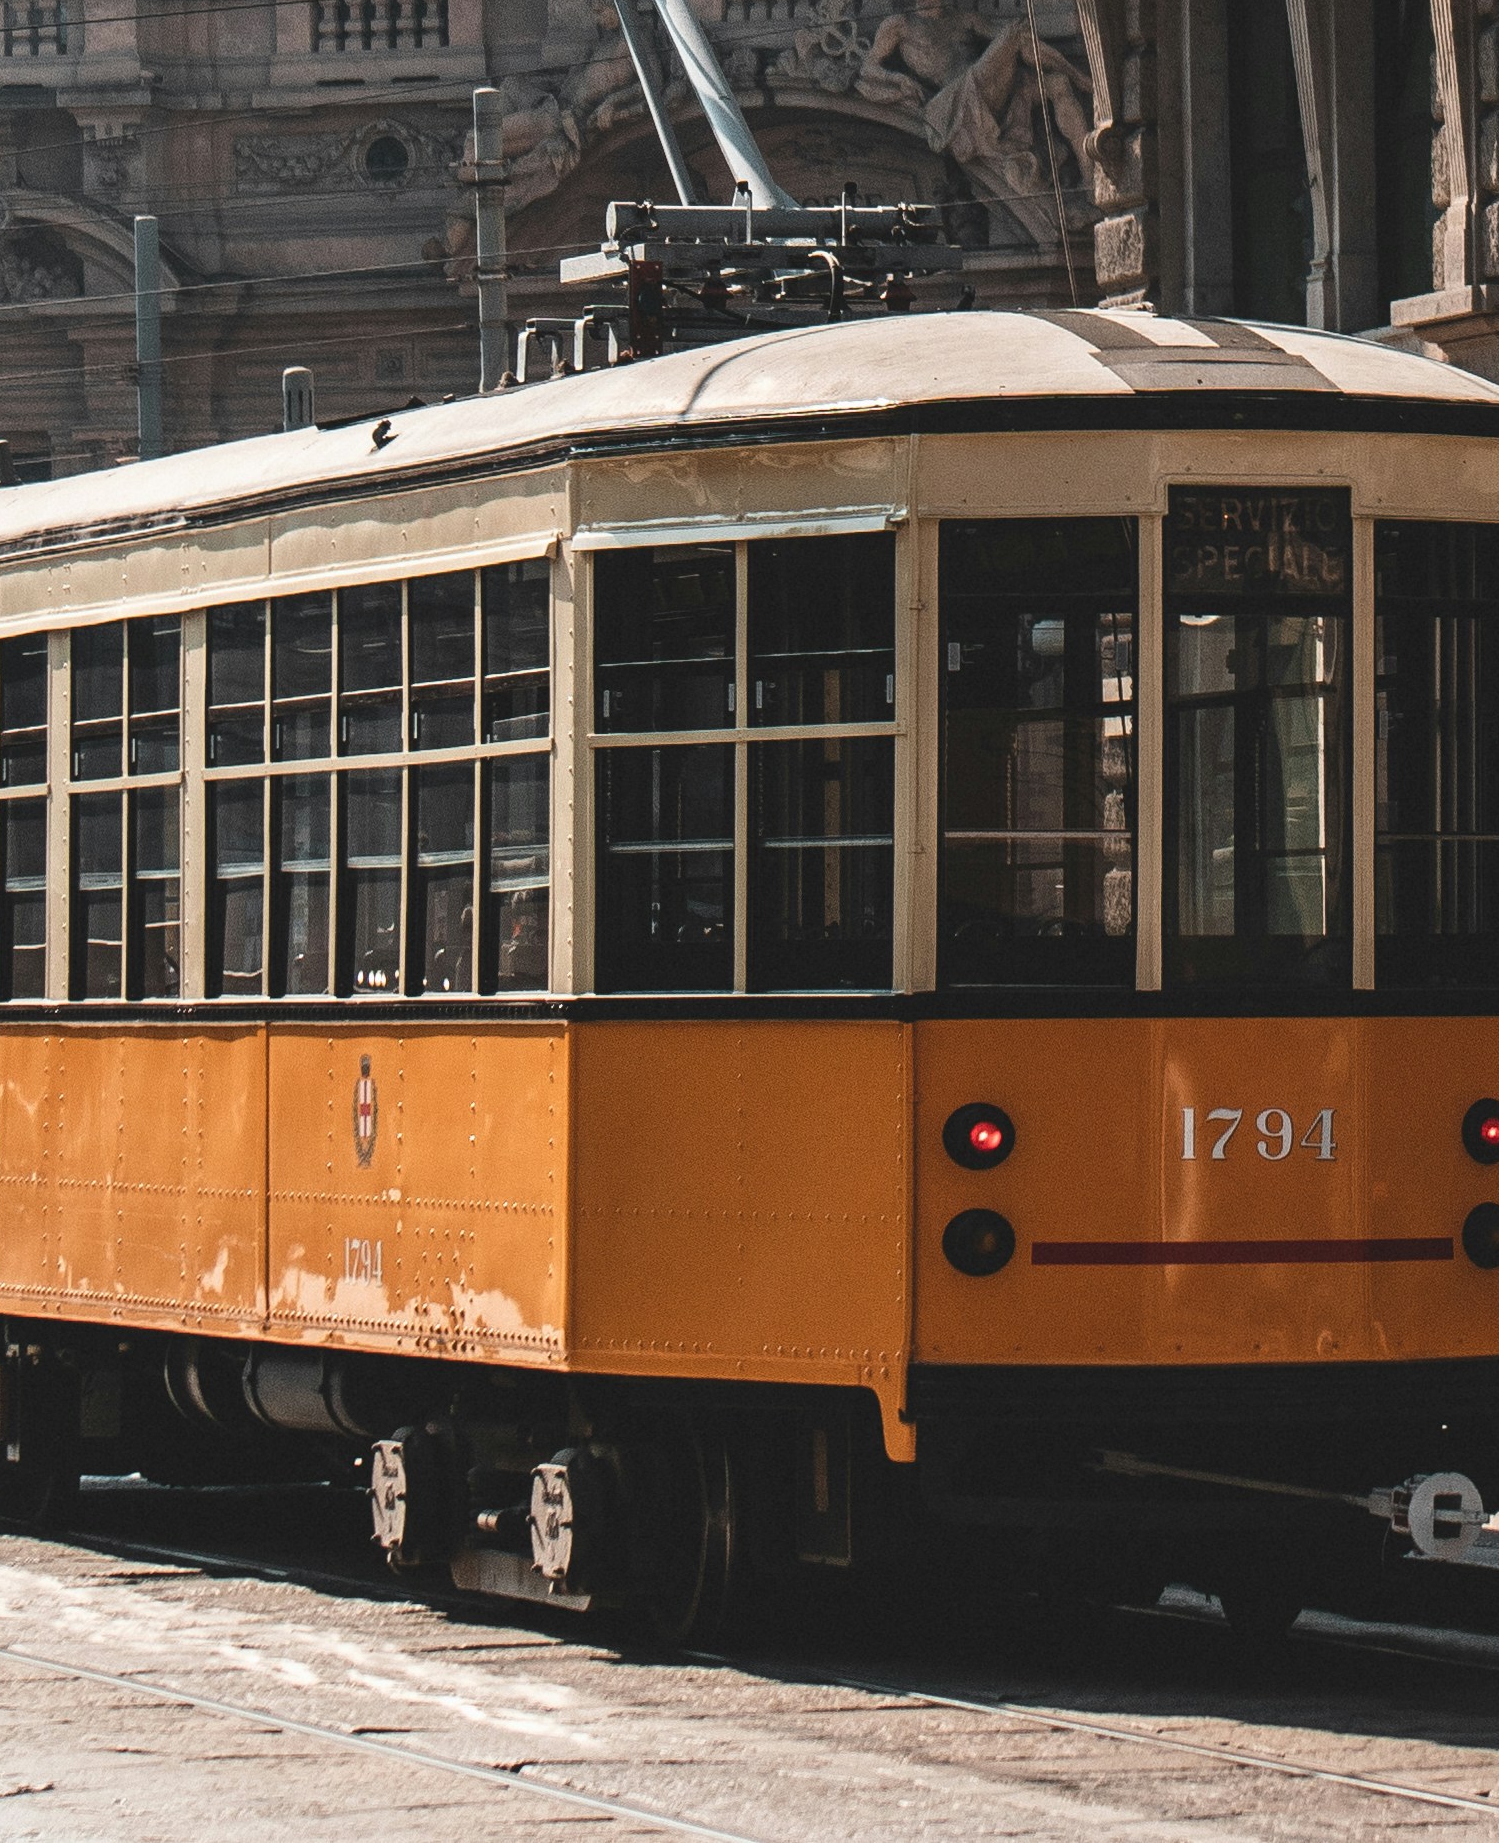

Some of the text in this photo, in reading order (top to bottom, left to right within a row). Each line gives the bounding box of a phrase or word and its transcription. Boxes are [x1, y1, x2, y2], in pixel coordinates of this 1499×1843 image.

[1174, 496, 1339, 532] SERVIZIO
[1173, 544, 1343, 582] SPECIALE
[1181, 1106, 1339, 1162] 1794
[342, 1237, 384, 1289] 1794
